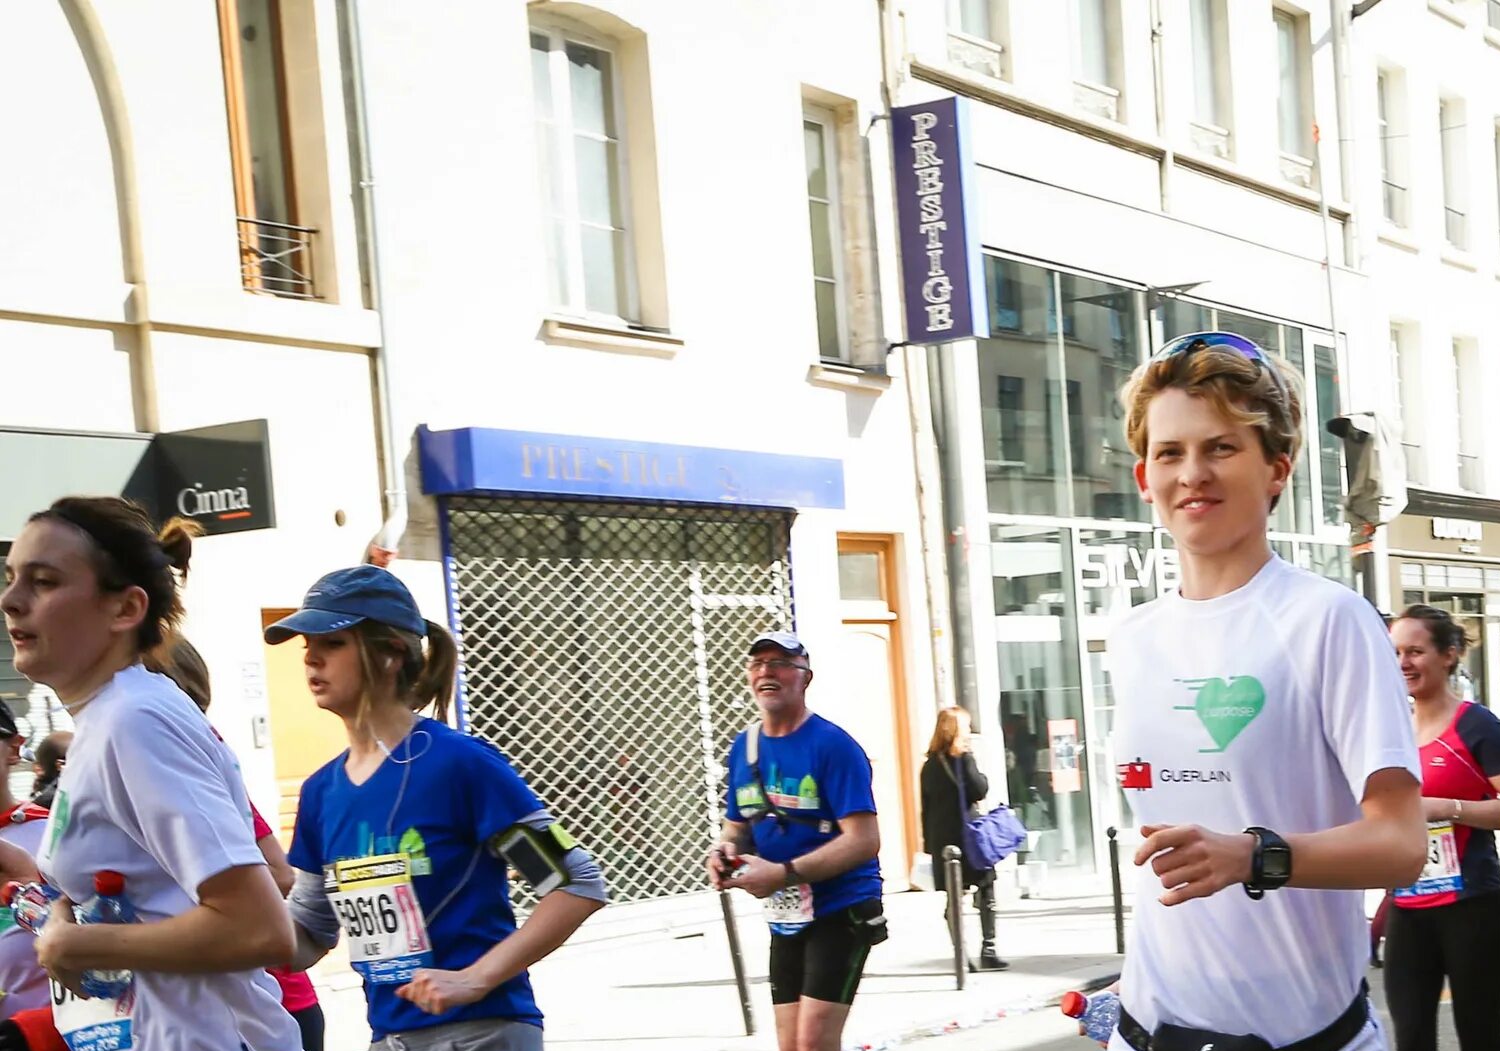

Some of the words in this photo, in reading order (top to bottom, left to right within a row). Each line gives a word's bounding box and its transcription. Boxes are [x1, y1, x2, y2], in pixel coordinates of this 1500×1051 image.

[911, 112, 954, 332] PRESTIGE
[521, 442, 693, 489] PRESTIGE
[177, 482, 251, 516] Cinna
[1080, 545, 1181, 588] SILVE
[1159, 769, 1232, 783] GUERLAIN
